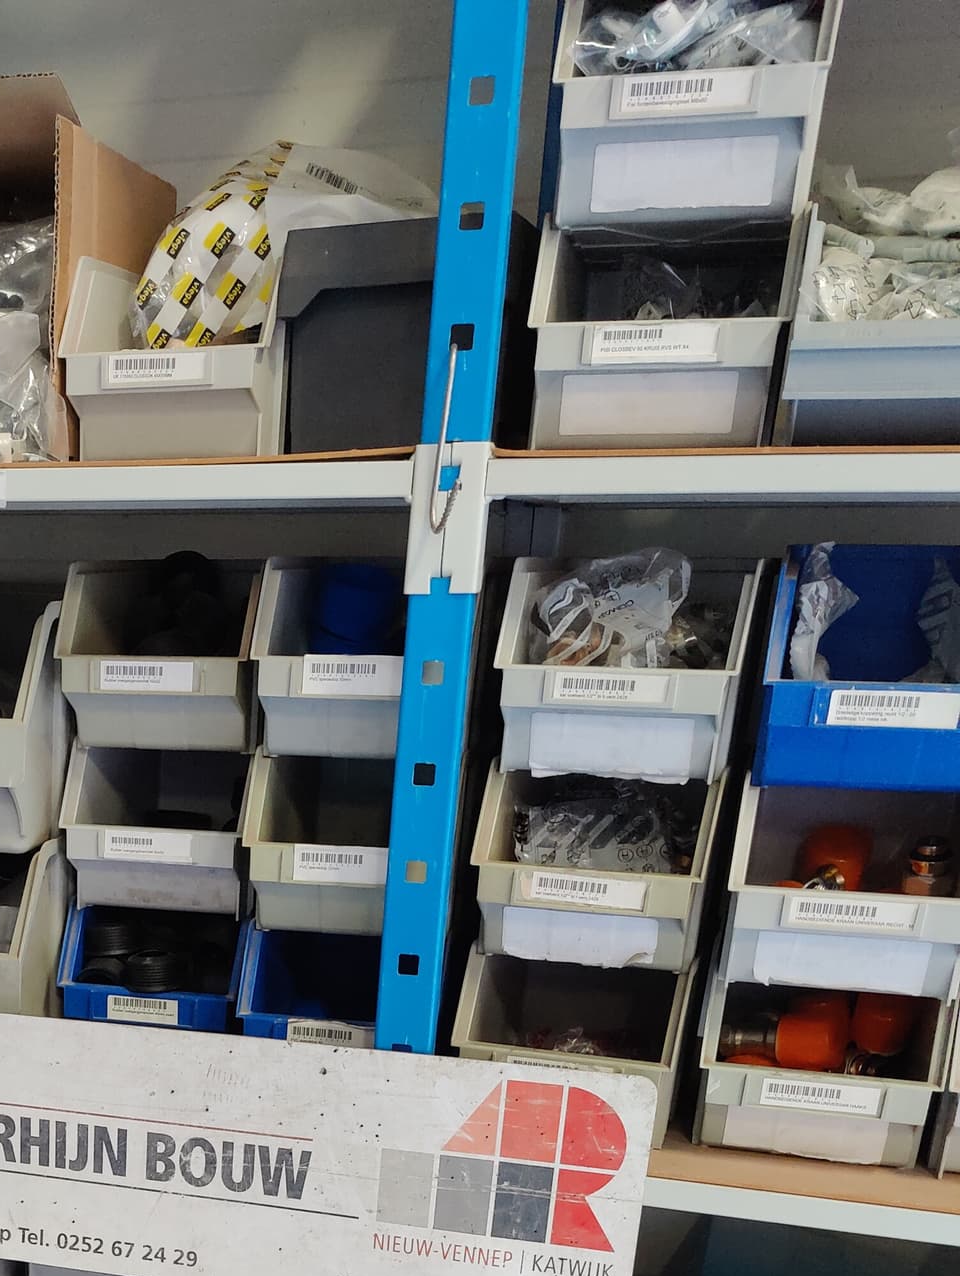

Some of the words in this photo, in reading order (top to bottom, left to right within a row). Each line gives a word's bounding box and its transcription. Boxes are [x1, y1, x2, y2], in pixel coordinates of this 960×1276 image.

[168, 230, 188, 256] viega
[214, 230, 234, 255] viega
[257, 239, 271, 256] ega
[138, 281, 156, 306] viega
[181, 280, 201, 306] viega
[225, 281, 244, 306] viega
[153, 332, 168, 349] vieg
[145, 1131, 313, 1200] BOUW
[17, 1226, 50, 1248] Tel.
[56, 1232, 105, 1255] 0252
[111, 1240, 135, 1259] 67
[141, 1244, 167, 1264] 24
[172, 1248, 198, 1268] 29
[372, 1232, 514, 1269] NIEUW-VENNEP
